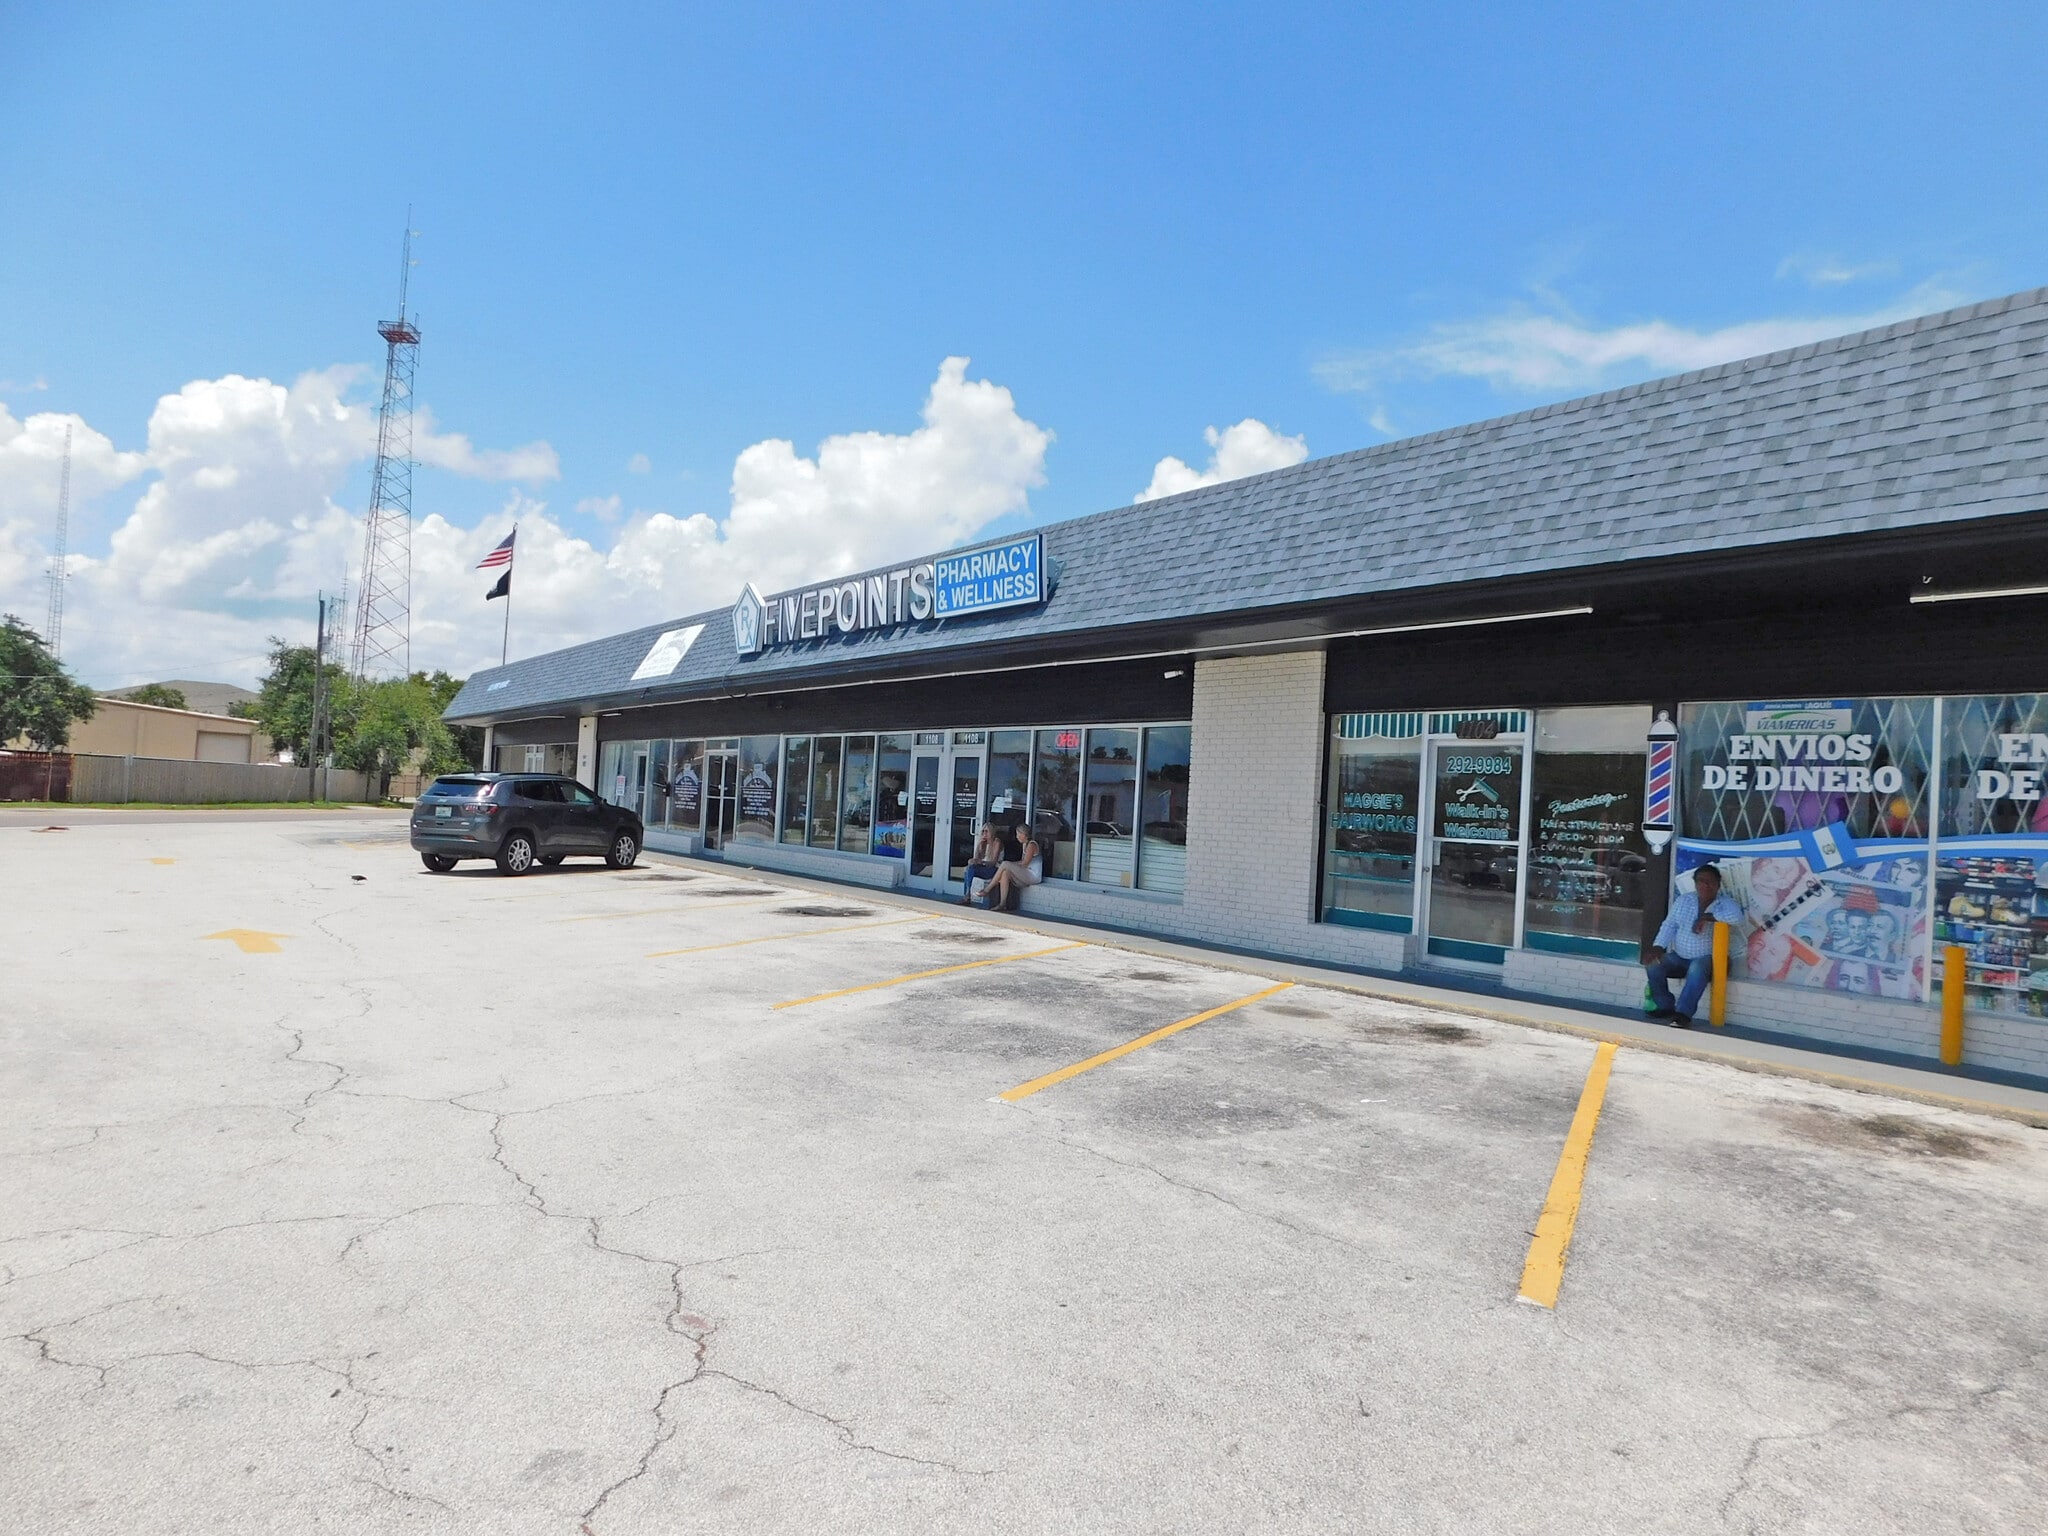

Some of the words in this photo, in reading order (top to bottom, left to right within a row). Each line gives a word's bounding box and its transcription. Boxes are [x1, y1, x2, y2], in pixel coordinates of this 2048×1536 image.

[938, 543, 1033, 586] PHARMACY
[938, 590, 947, 610] &
[951, 572, 1036, 608] WELLNESS
[1757, 719, 1837, 730] VIAMERICAS
[1056, 733, 1079, 747] OPEN
[1730, 734, 1872, 761] ENVIOS
[1447, 756, 1511, 774] 292-9984
[1702, 765, 1747, 790] DE
[1755, 765, 1902, 793] DINERO
[1976, 770, 2040, 800] DE
[1344, 793, 1404, 810] MAGGIE'S
[1444, 823, 1509, 840] Welcome
